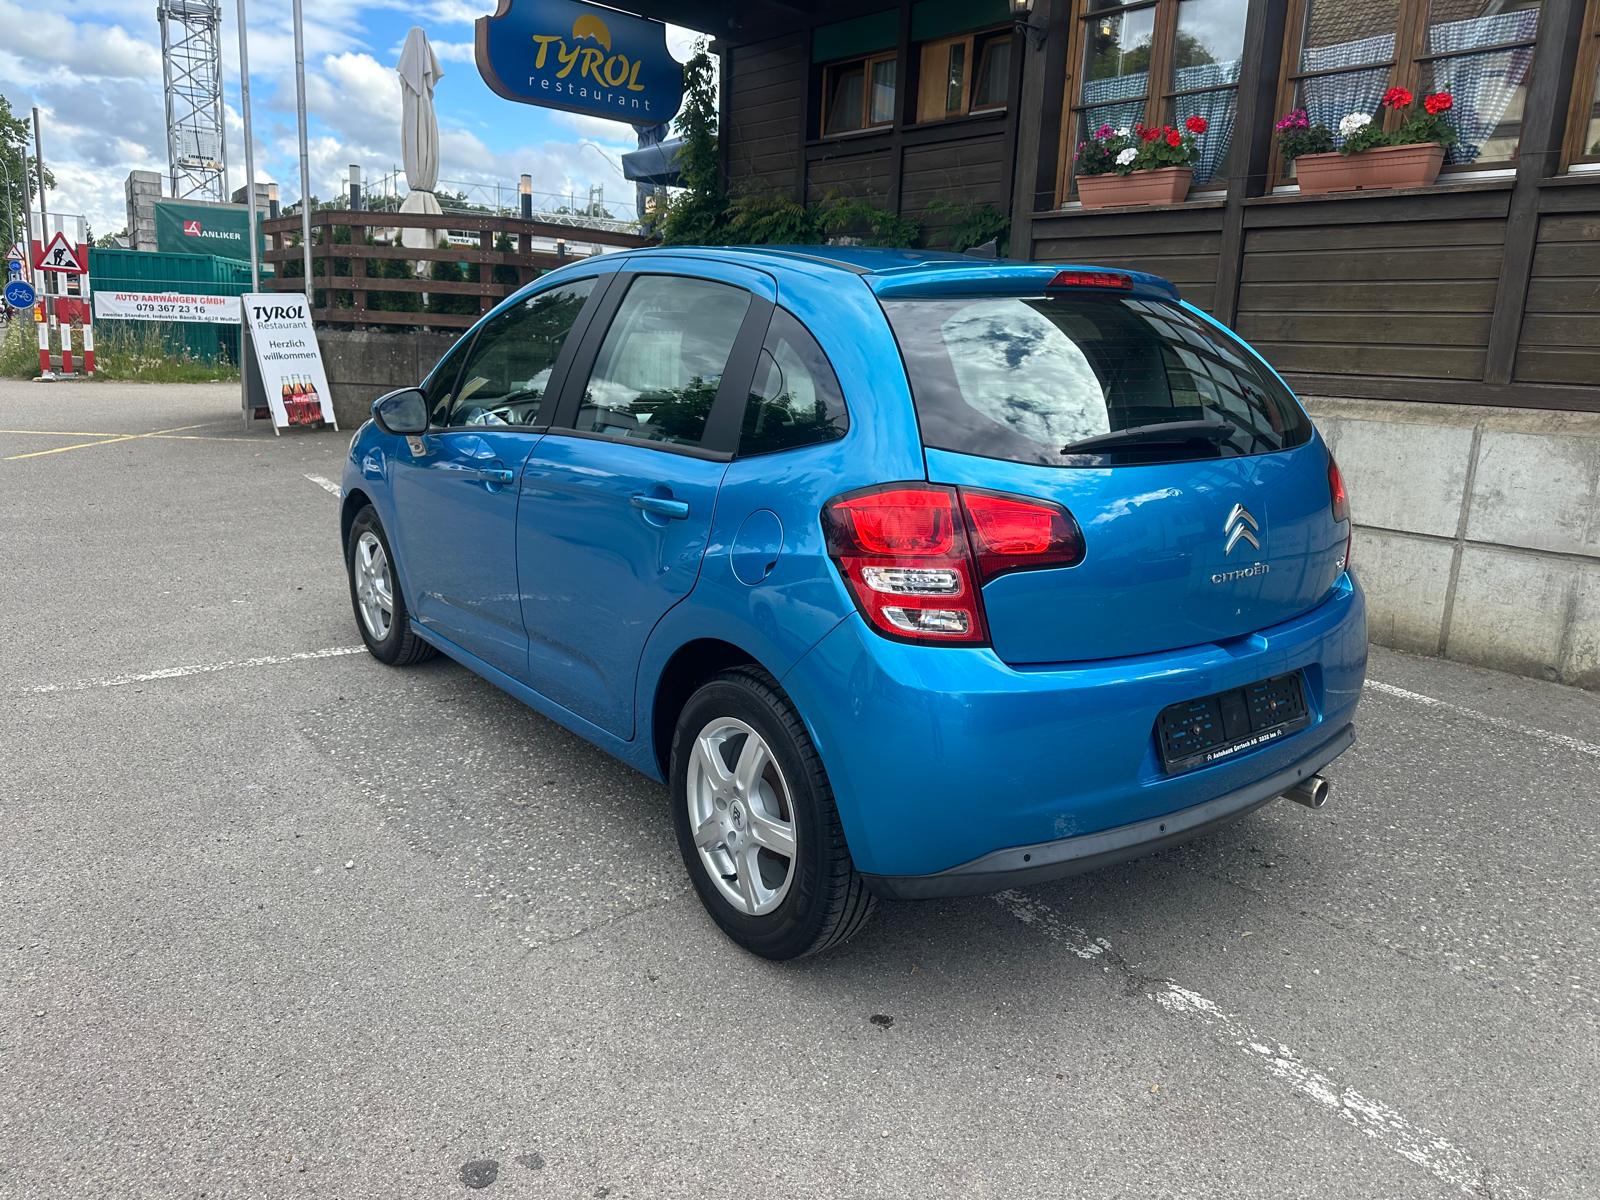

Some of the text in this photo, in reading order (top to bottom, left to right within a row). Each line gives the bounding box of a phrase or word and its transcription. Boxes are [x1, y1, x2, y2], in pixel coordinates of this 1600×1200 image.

[532, 34, 645, 92] TYROL
[529, 75, 651, 111] restaurant
[202, 230, 241, 240] ANLIKER
[115, 294, 226, 305] AUTO AARWANGEN GMBH
[136, 304, 155, 312] 079
[157, 305, 175, 313] 367
[193, 306, 206, 314] 16
[253, 305, 305, 323] TYROL
[257, 321, 308, 330] Restaurant
[269, 339, 306, 348] Herzlich
[263, 352, 317, 360] willkommen
[1213, 747, 1234, 759] Autohaus
